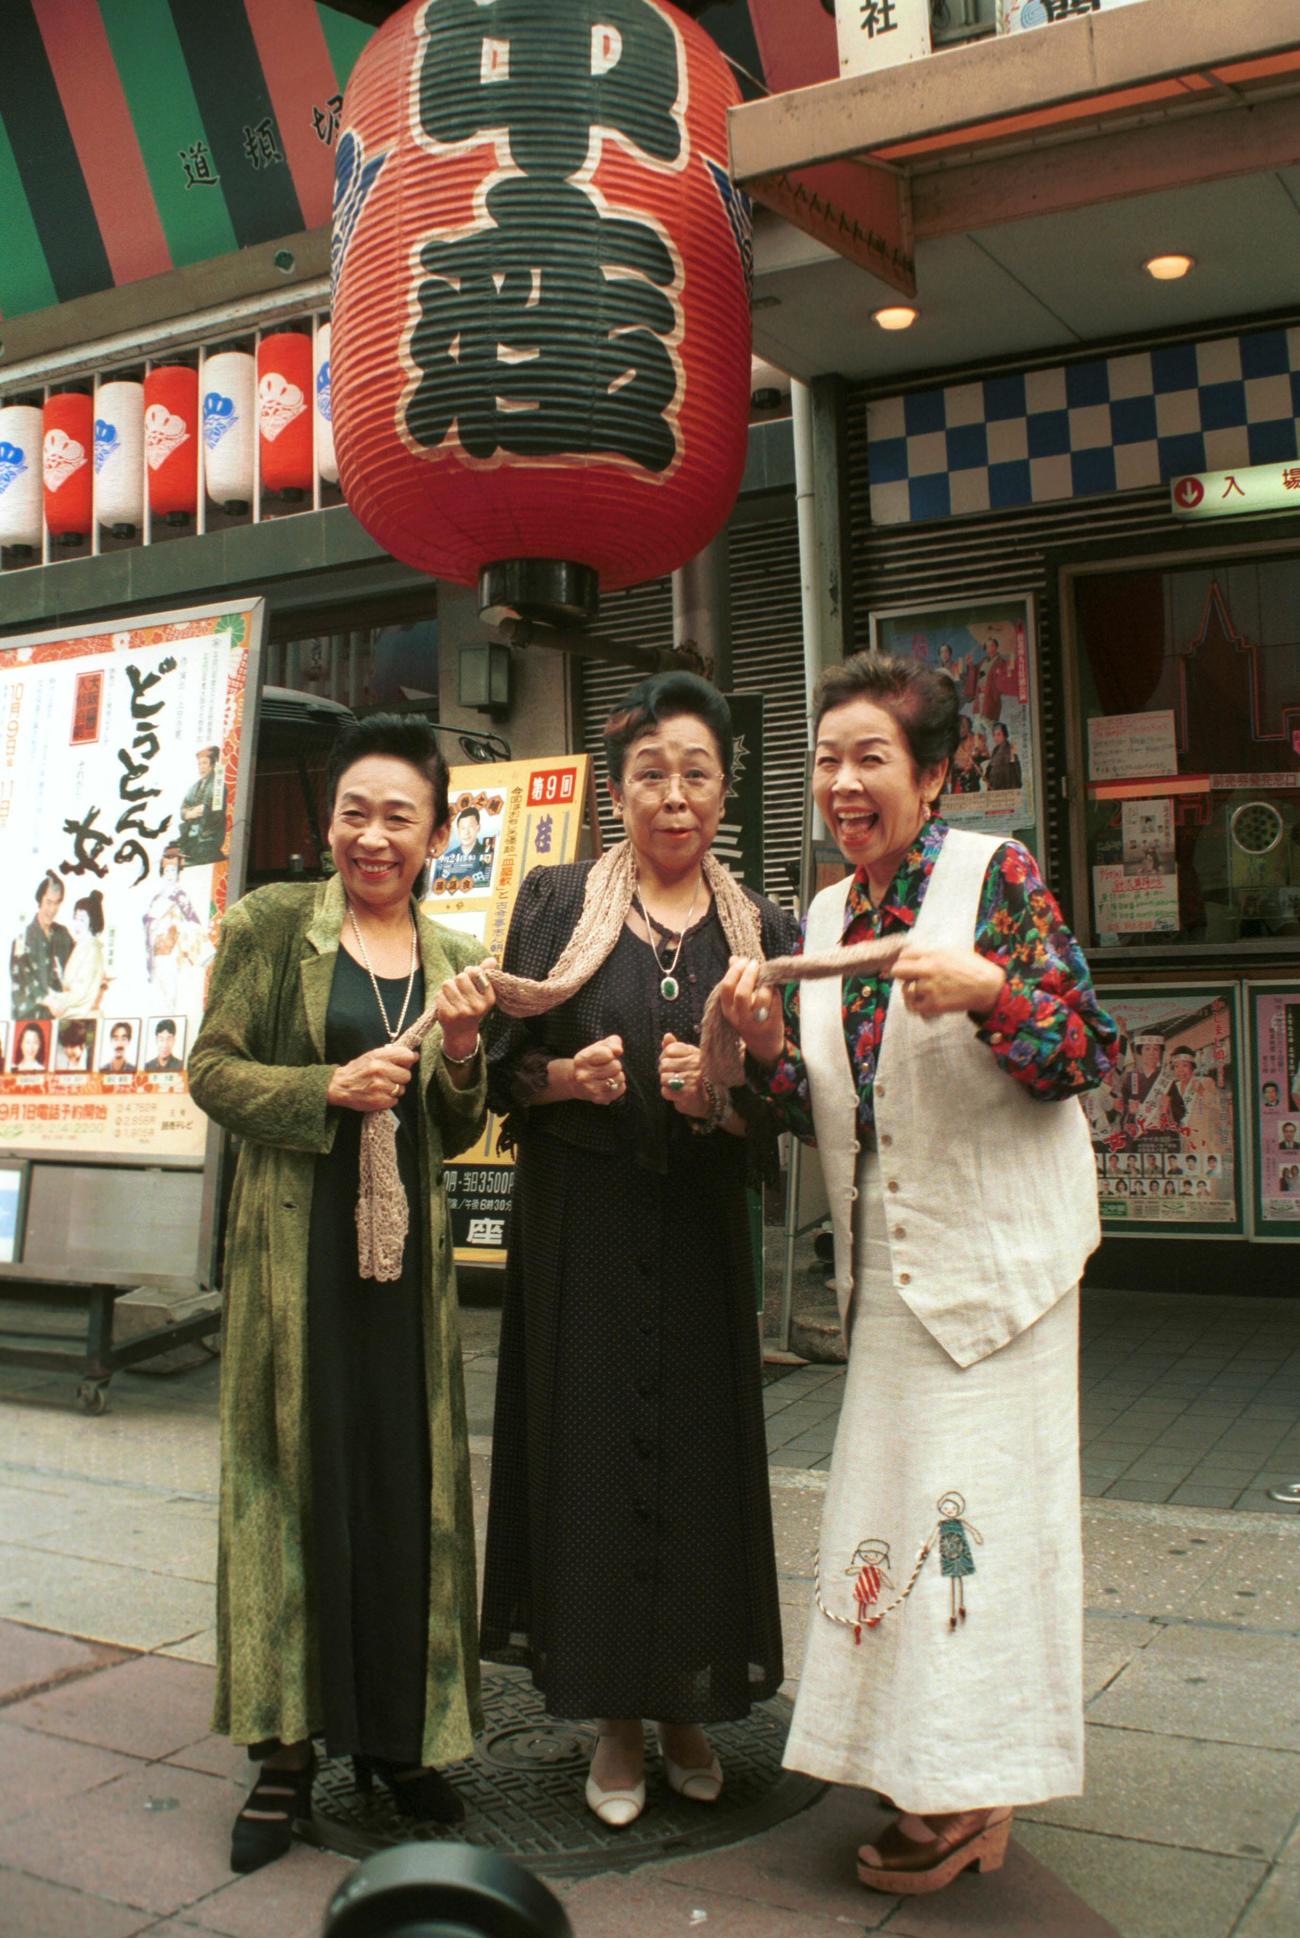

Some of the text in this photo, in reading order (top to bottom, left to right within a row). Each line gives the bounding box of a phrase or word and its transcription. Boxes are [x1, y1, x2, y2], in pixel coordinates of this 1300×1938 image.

[860, 0, 898, 38] 社
[1221, 466, 1300, 498] 入場
[531, 774, 574, 800] 第9回
[466, 1218, 505, 1245] 座
